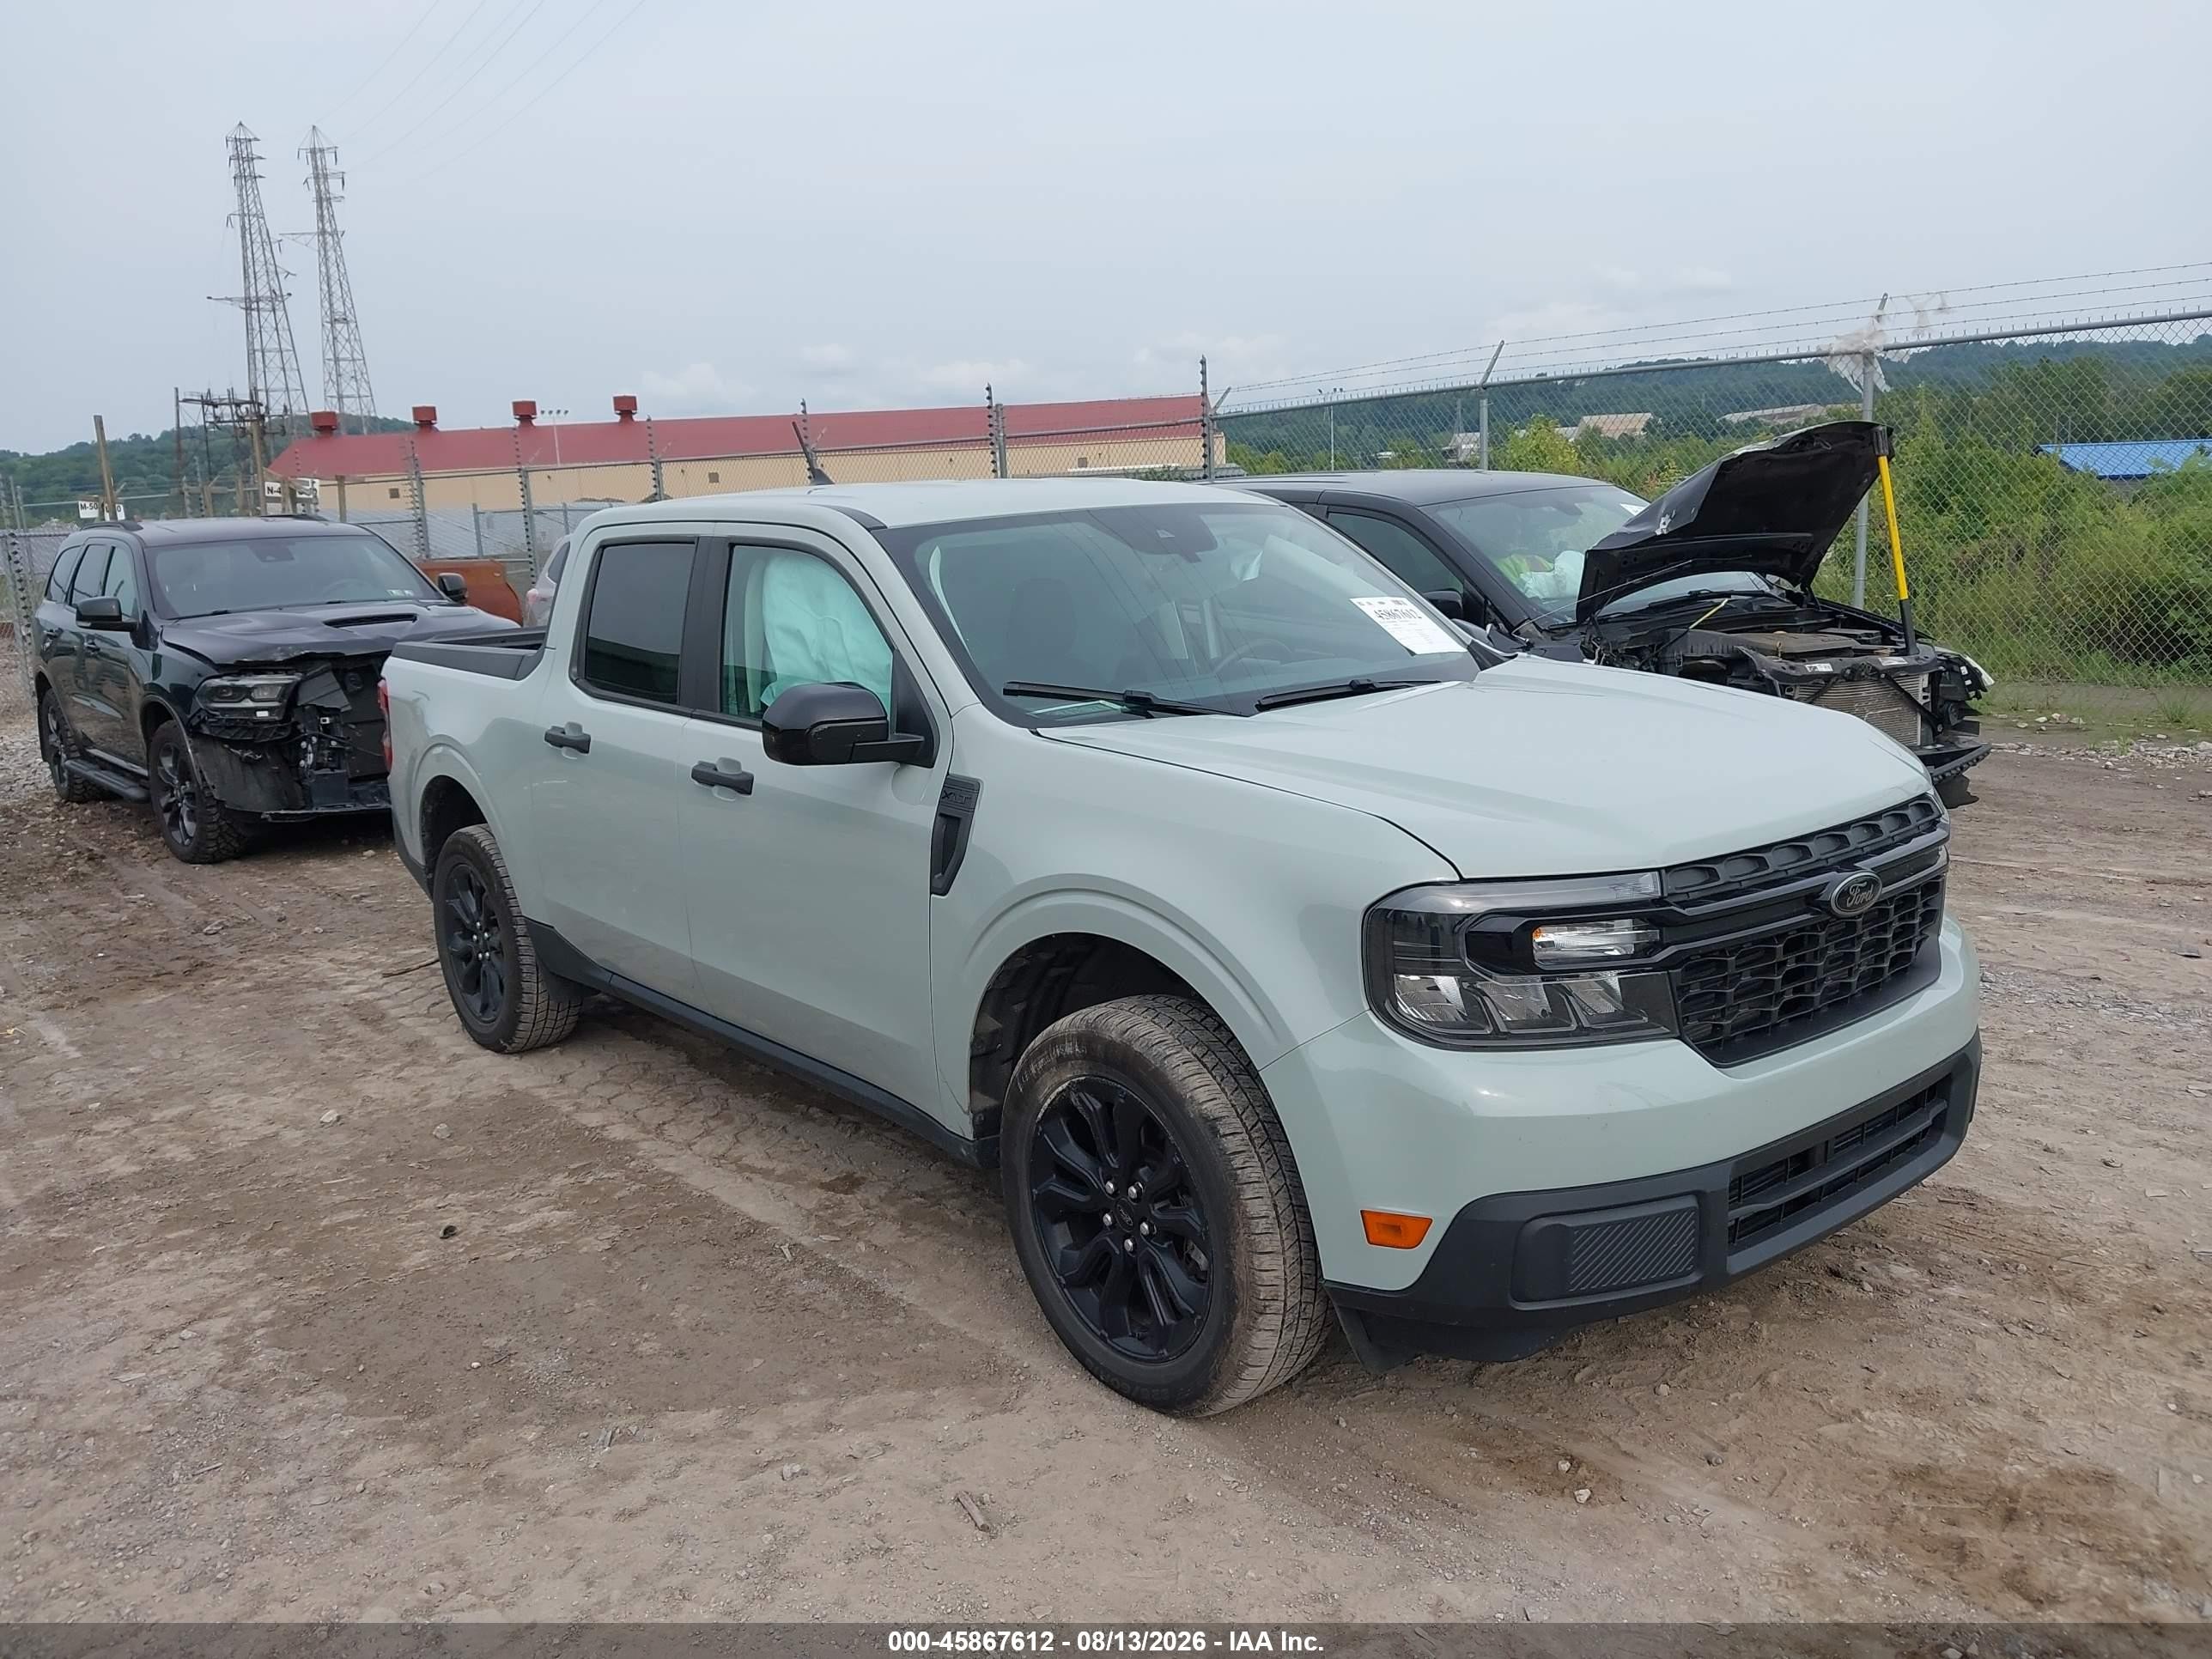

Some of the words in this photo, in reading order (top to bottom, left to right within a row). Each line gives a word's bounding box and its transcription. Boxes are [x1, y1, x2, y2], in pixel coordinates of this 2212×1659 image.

[80, 502, 98, 511] M-50
[1374, 608, 1423, 619] 45867612
[1847, 882, 1874, 908] Ford
